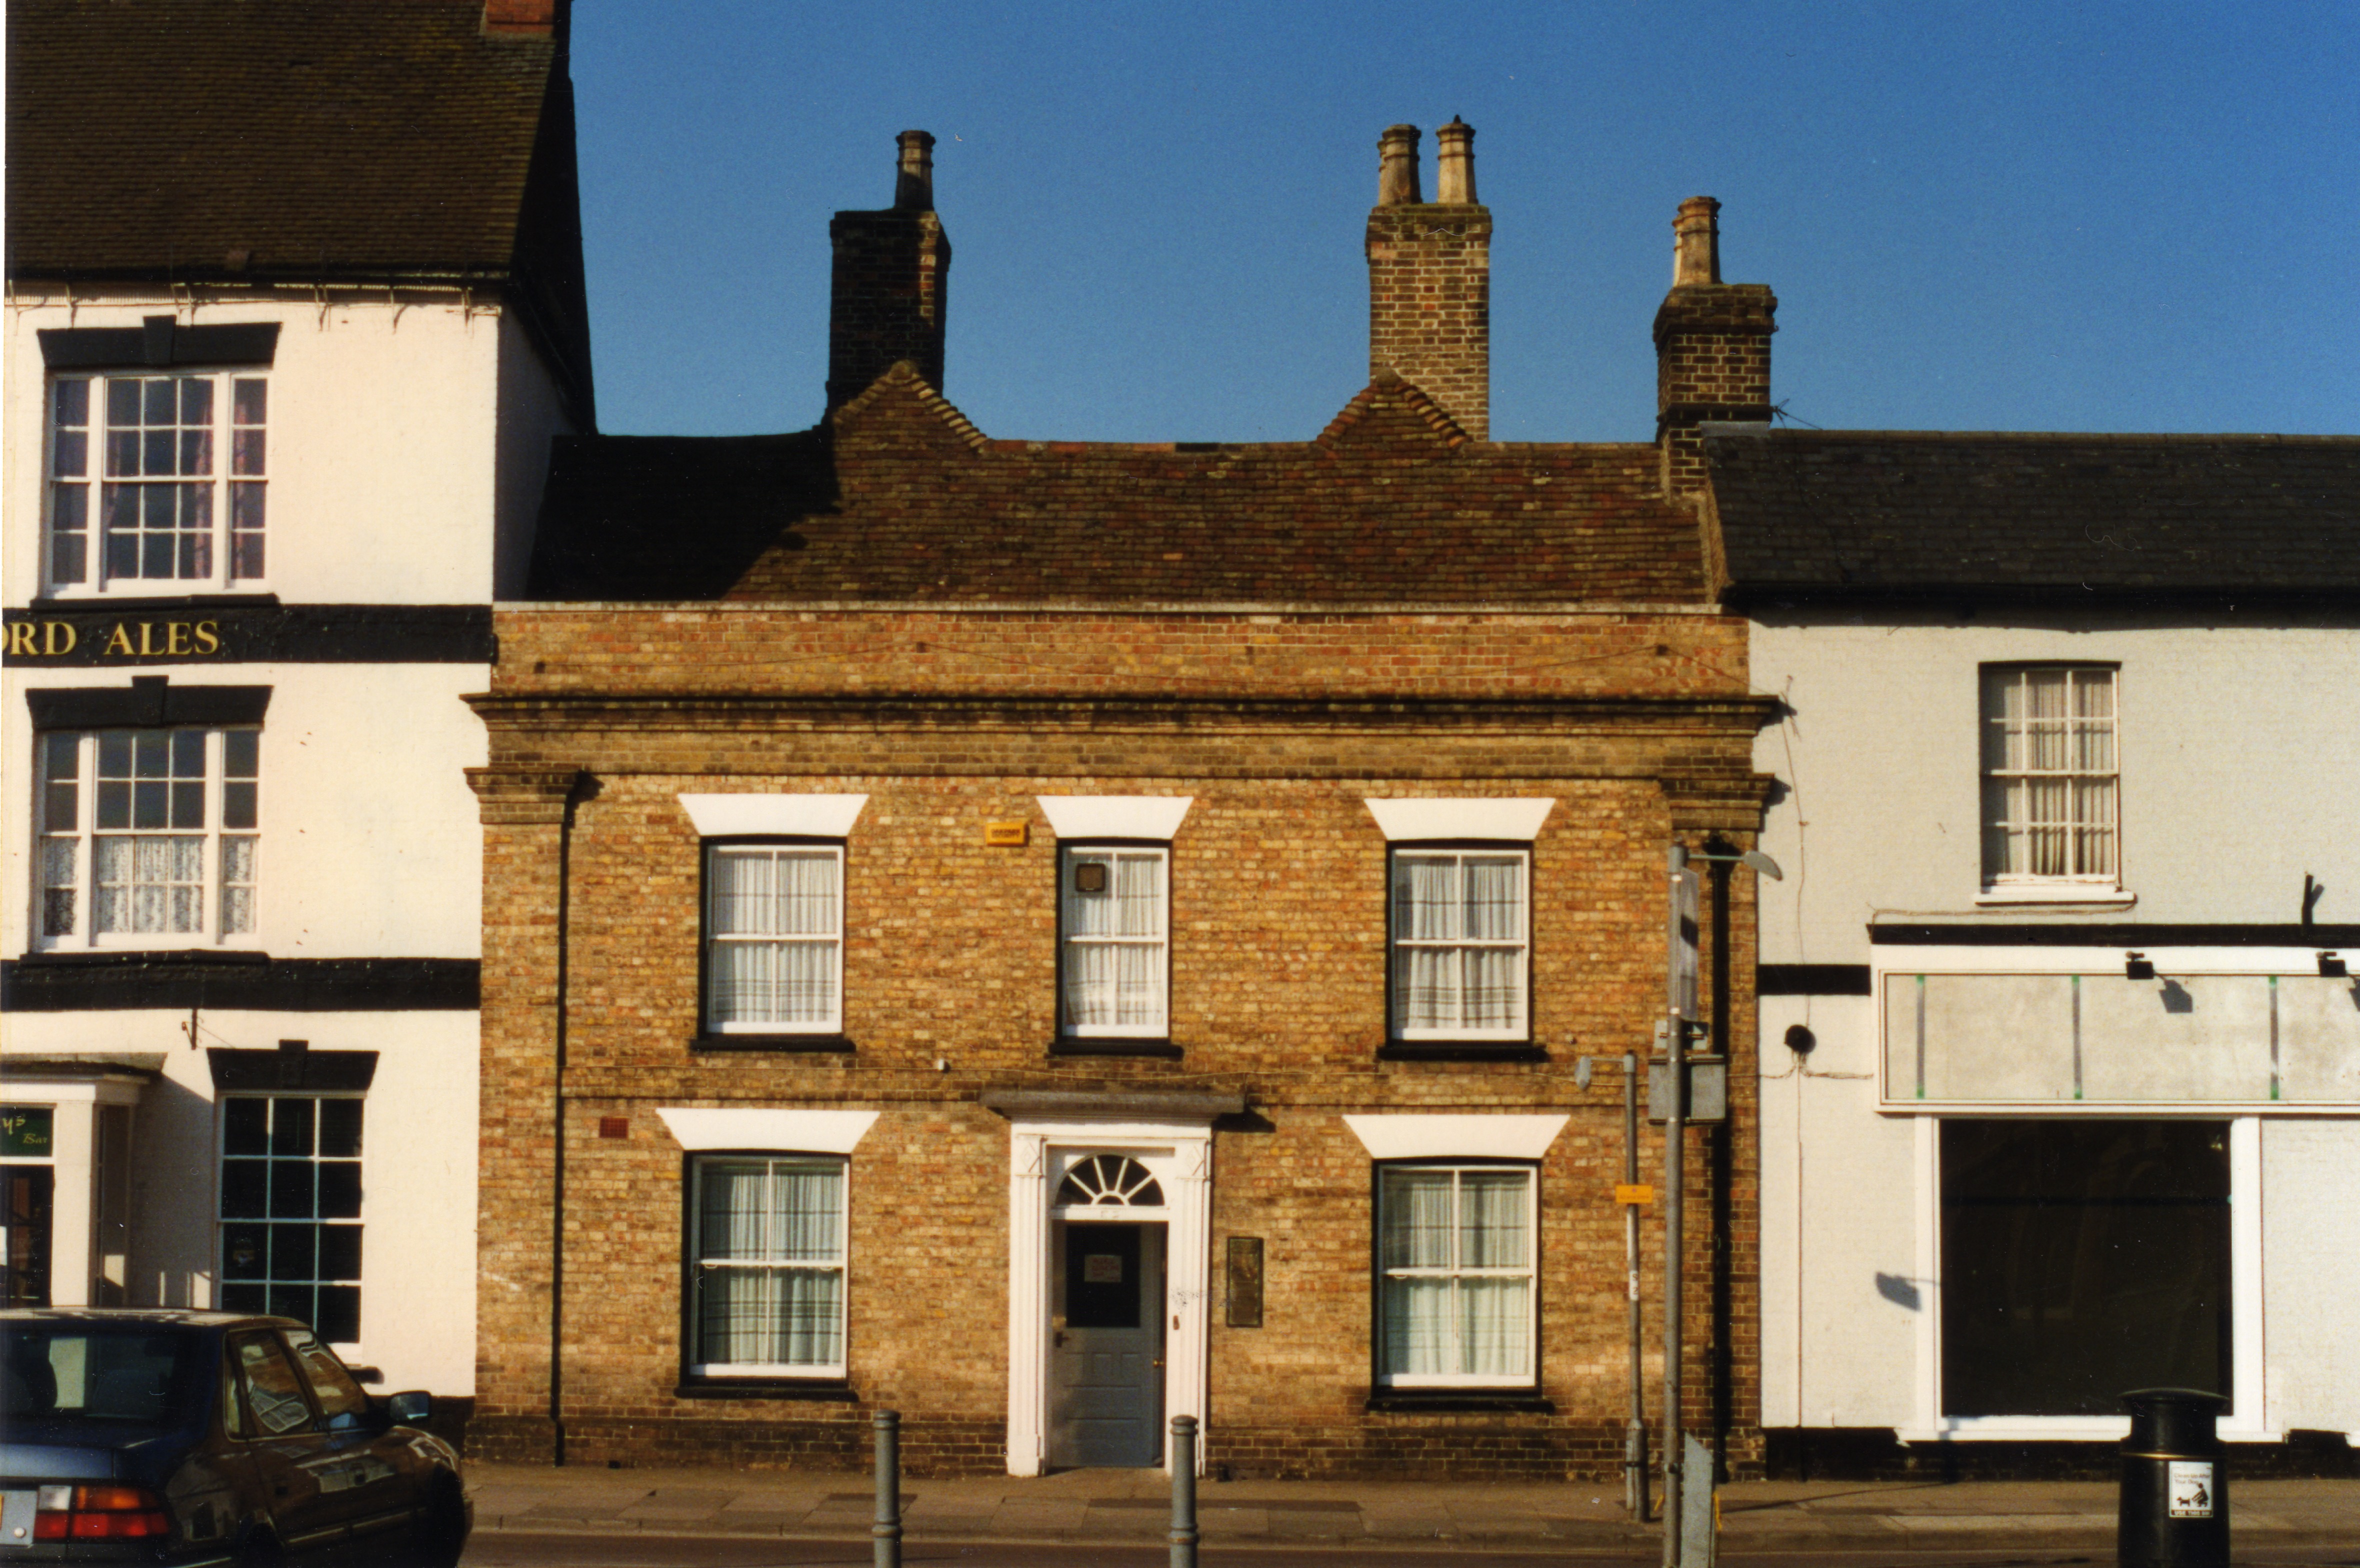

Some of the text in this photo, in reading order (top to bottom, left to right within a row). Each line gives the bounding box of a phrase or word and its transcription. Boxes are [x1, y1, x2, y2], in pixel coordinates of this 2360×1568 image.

[2, 620, 219, 655] RD ALES
[24, 1133, 48, 1144] Bar
